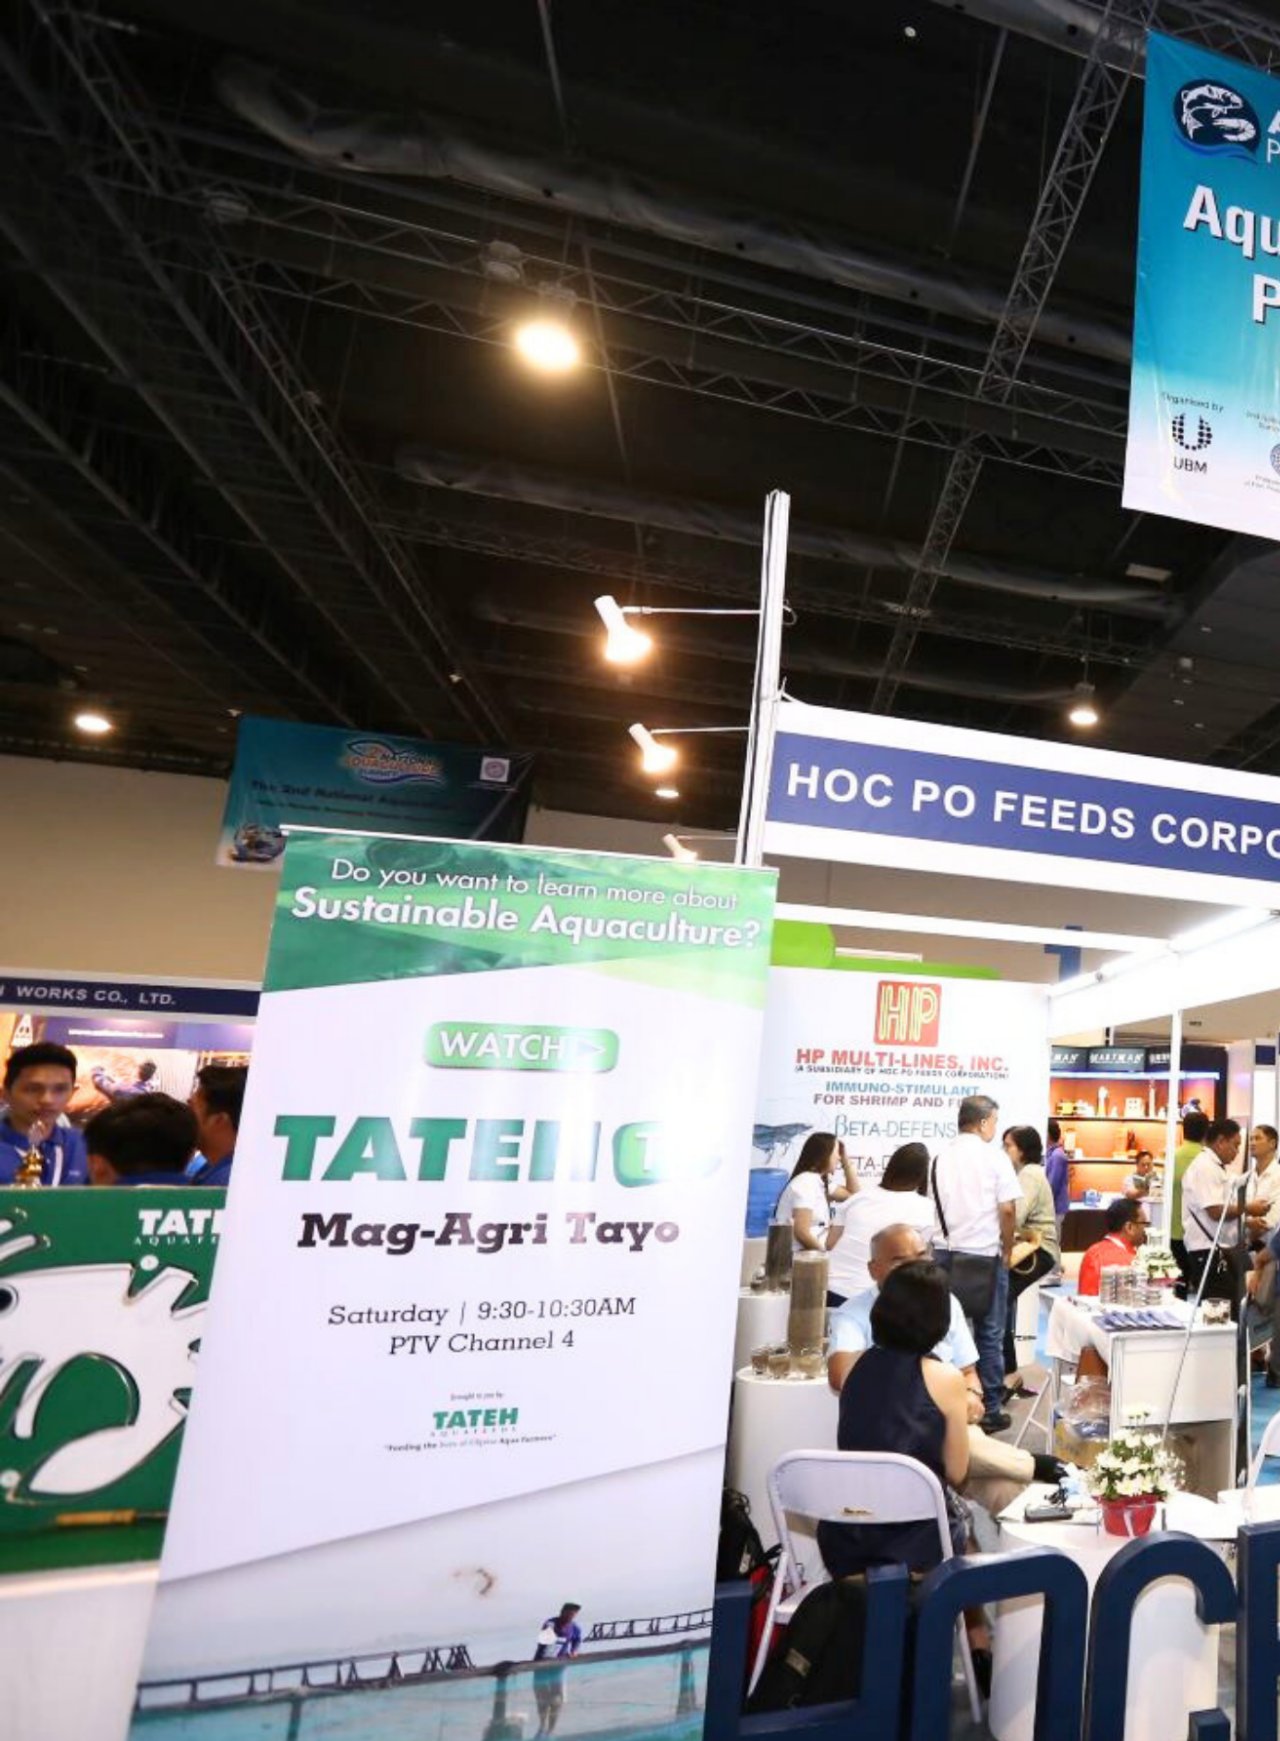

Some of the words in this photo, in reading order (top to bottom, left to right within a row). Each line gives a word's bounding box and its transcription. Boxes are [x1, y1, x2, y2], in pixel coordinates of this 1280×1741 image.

[1173, 456, 1208, 474] UBM
[787, 763, 895, 808] HOC
[911, 780, 976, 820] PO
[993, 791, 1136, 839] FEEDS
[331, 859, 370, 881] Do
[379, 867, 427, 889] you
[437, 871, 499, 892] want
[505, 877, 529, 895] to
[537, 877, 598, 899] learn
[607, 888, 665, 905] more
[673, 888, 738, 911] about
[291, 886, 519, 931] Sustainable
[530, 904, 761, 949] Aquaculture?
[16, 985, 88, 1001] WORKS
[94, 990, 128, 1004] CO.,
[139, 992, 176, 1005] LTD.
[878, 983, 938, 1043] HP
[439, 1030, 563, 1061] WATCH
[796, 1049, 825, 1065] HP
[832, 1050, 964, 1071] MULTI-LINES,
[970, 1055, 1009, 1072] INC.
[807, 1065, 862, 1075] SUBSIDIARY
[813, 1093, 845, 1106] FOR
[849, 1095, 907, 1107] SHRIMP
[912, 1097, 943, 1108] AND
[826, 1080, 980, 1096] IMMUNO-STIMULANT
[273, 1115, 602, 1182] TATEH
[297, 1212, 548, 1256] Mag-Agri
[566, 1212, 680, 1252] Tayo
[328, 1304, 448, 1326] Saturday
[477, 1297, 636, 1321] 9:30-10:30AM
[388, 1334, 441, 1356] PTV
[447, 1331, 555, 1353] Channel
[561, 1331, 575, 1348] 4
[433, 1407, 518, 1430] TATEH
